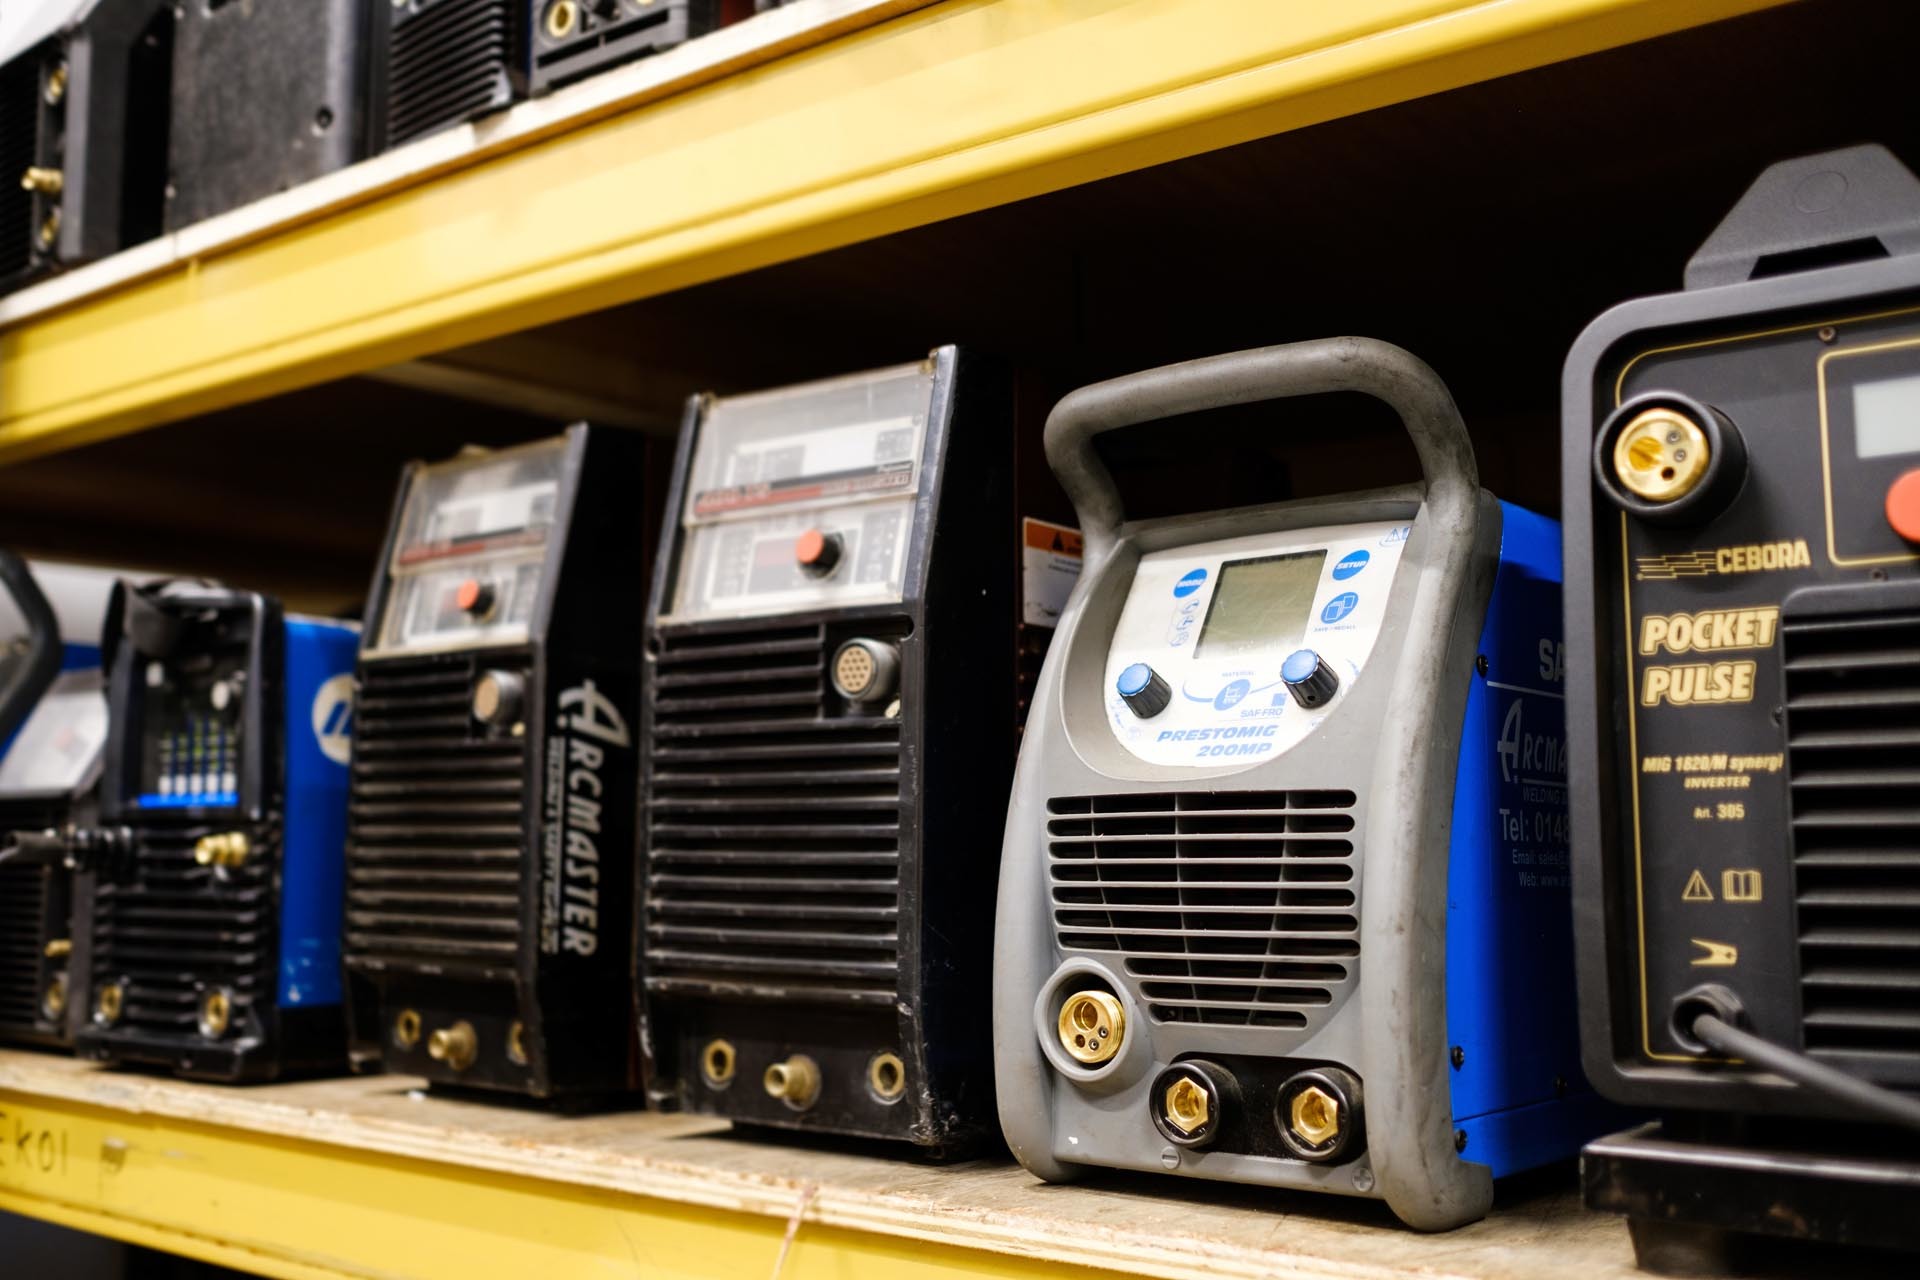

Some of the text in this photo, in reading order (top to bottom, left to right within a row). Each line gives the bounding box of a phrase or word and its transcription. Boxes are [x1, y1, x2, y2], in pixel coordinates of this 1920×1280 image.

[1335, 560, 1368, 570] SETUP
[1716, 540, 1812, 574] CEBORA
[1640, 606, 1780, 655] POCKET
[1642, 661, 1756, 705] PULSE
[1157, 725, 1279, 743] PRESTOMIG
[1195, 743, 1273, 758] 200MP
[1642, 756, 1672, 773] MIG
[1684, 775, 1751, 789] INVERTER
[1522, 786, 1560, 804] WELDING
[557, 678, 631, 957] ARCMASTER
[1716, 802, 1746, 820] 305
[1499, 808, 1530, 842] Tel:
[1518, 871, 1539, 888] Web:
